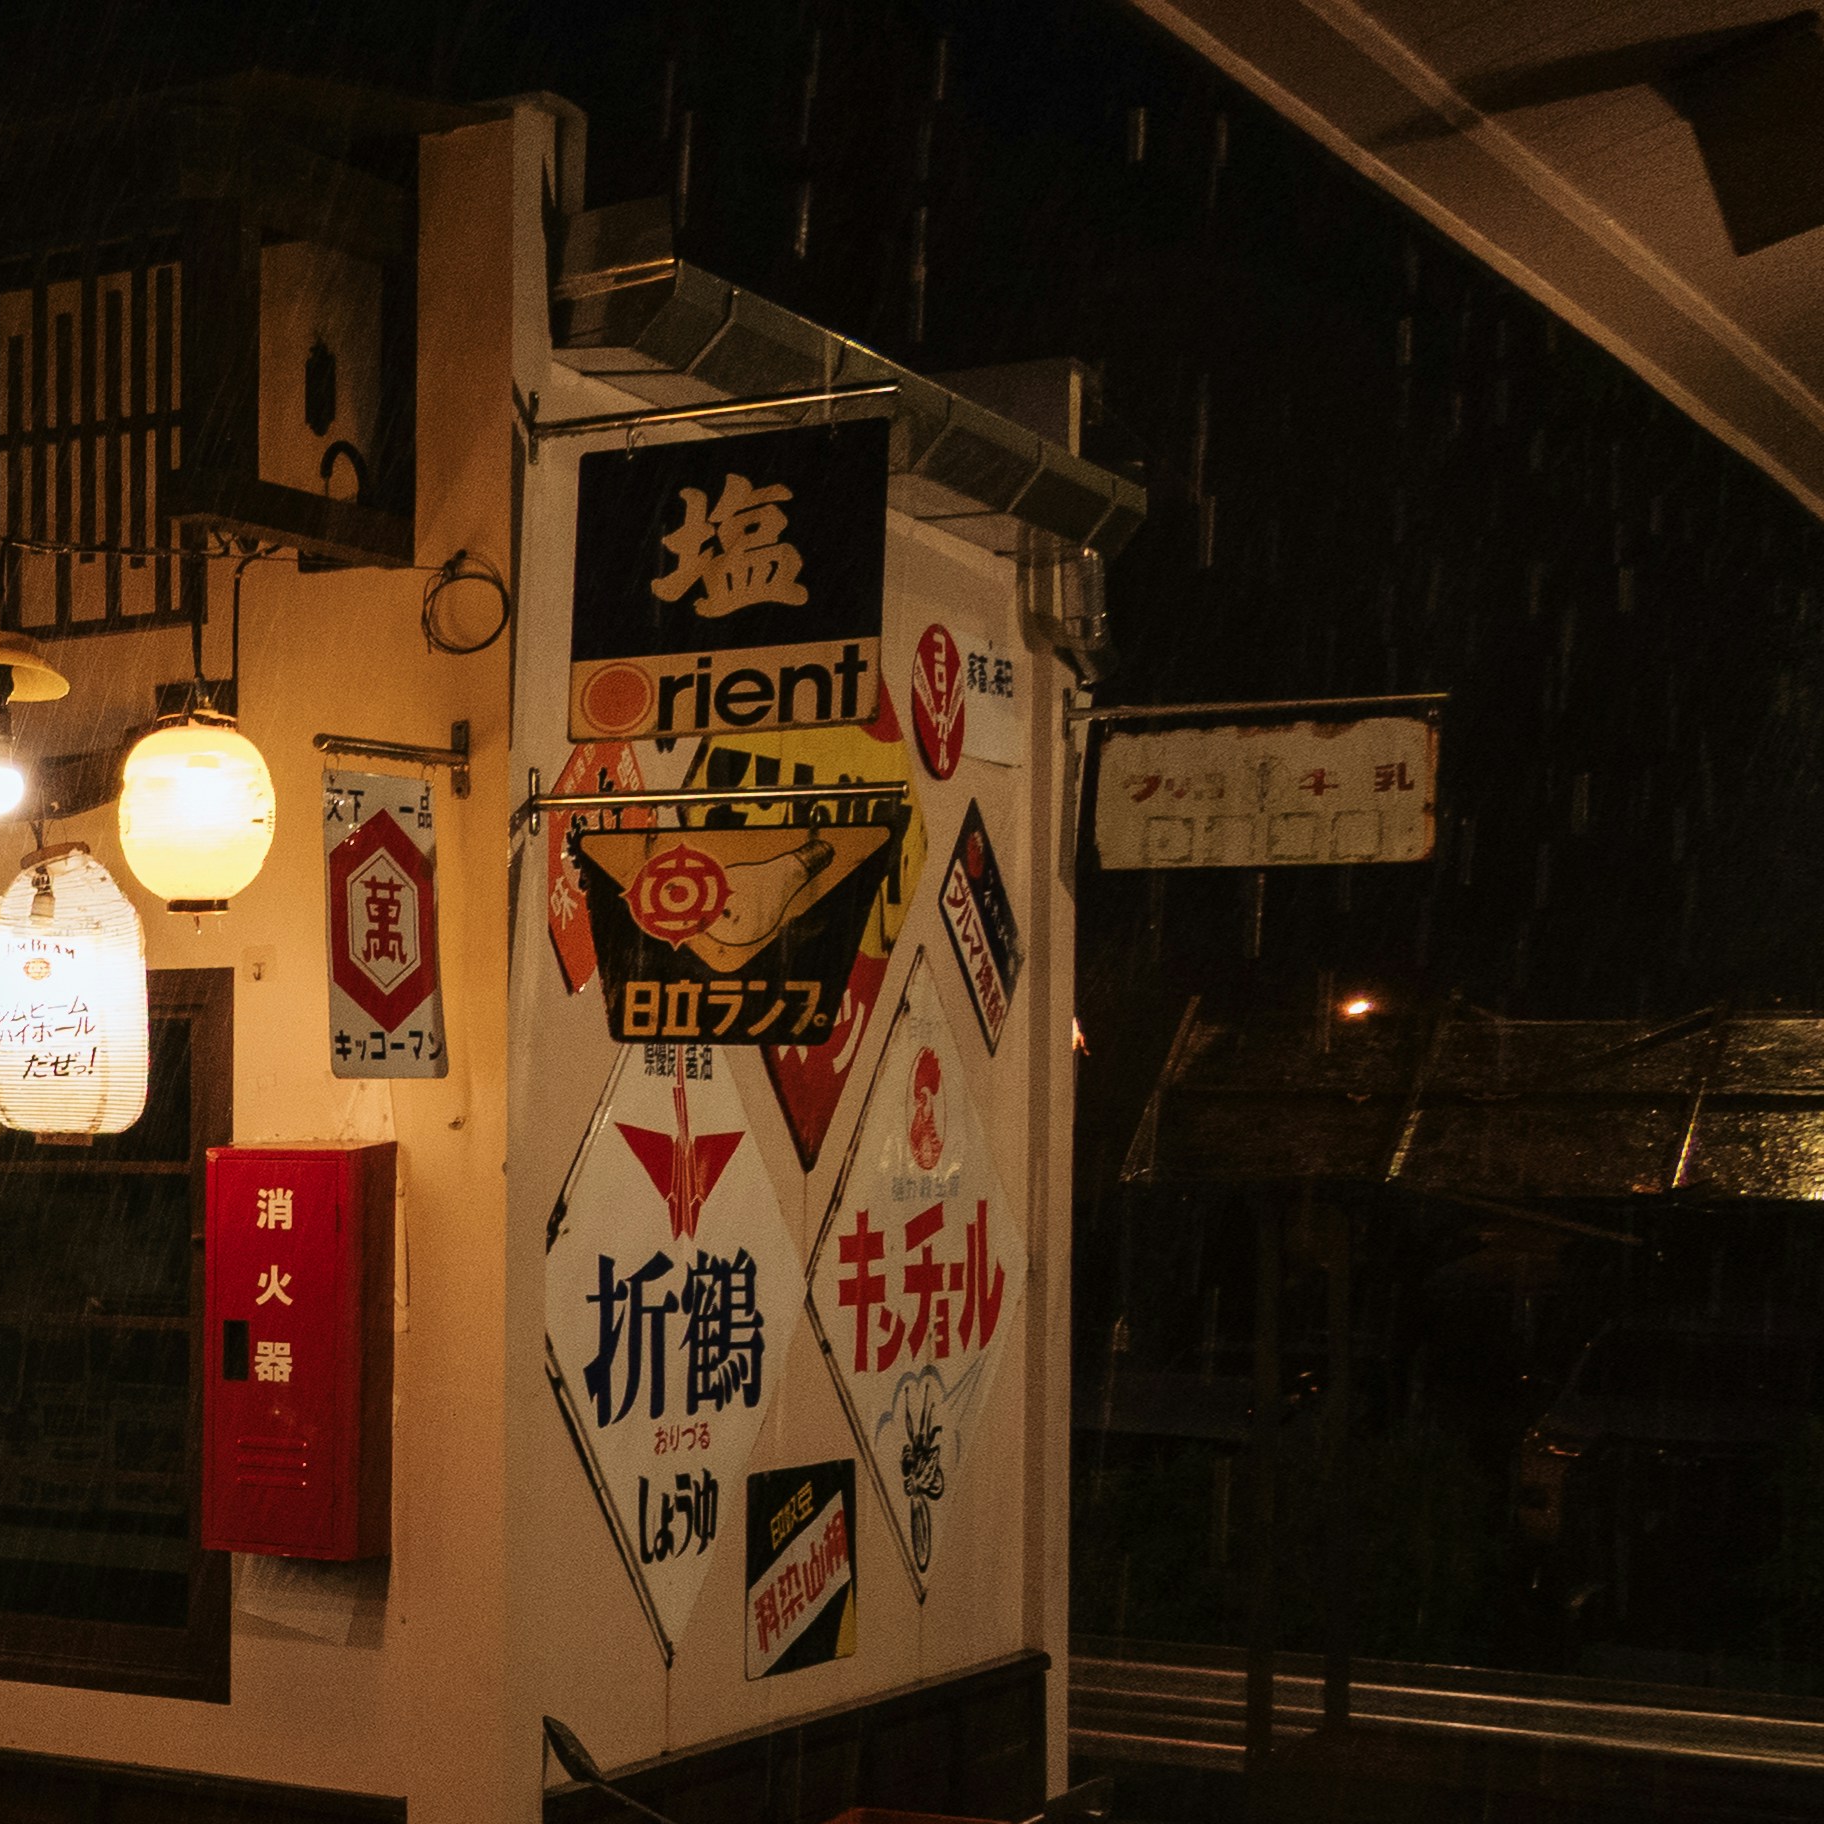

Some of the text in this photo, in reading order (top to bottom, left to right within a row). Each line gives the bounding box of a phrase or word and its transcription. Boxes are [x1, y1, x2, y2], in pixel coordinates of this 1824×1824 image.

[651, 471, 809, 619] 塩
[334, 1030, 442, 1062] キッコーマン
[622, 978, 828, 1038] 日立ランプ
[23, 1046, 97, 1078] だぜっ!
[255, 1187, 294, 1383] 消火器
[838, 1199, 1005, 1373] キンチョール
[583, 1248, 764, 1428] 折鶴
[654, 1422, 711, 1456] おりづる
[638, 1468, 719, 1565] しょうゆ
